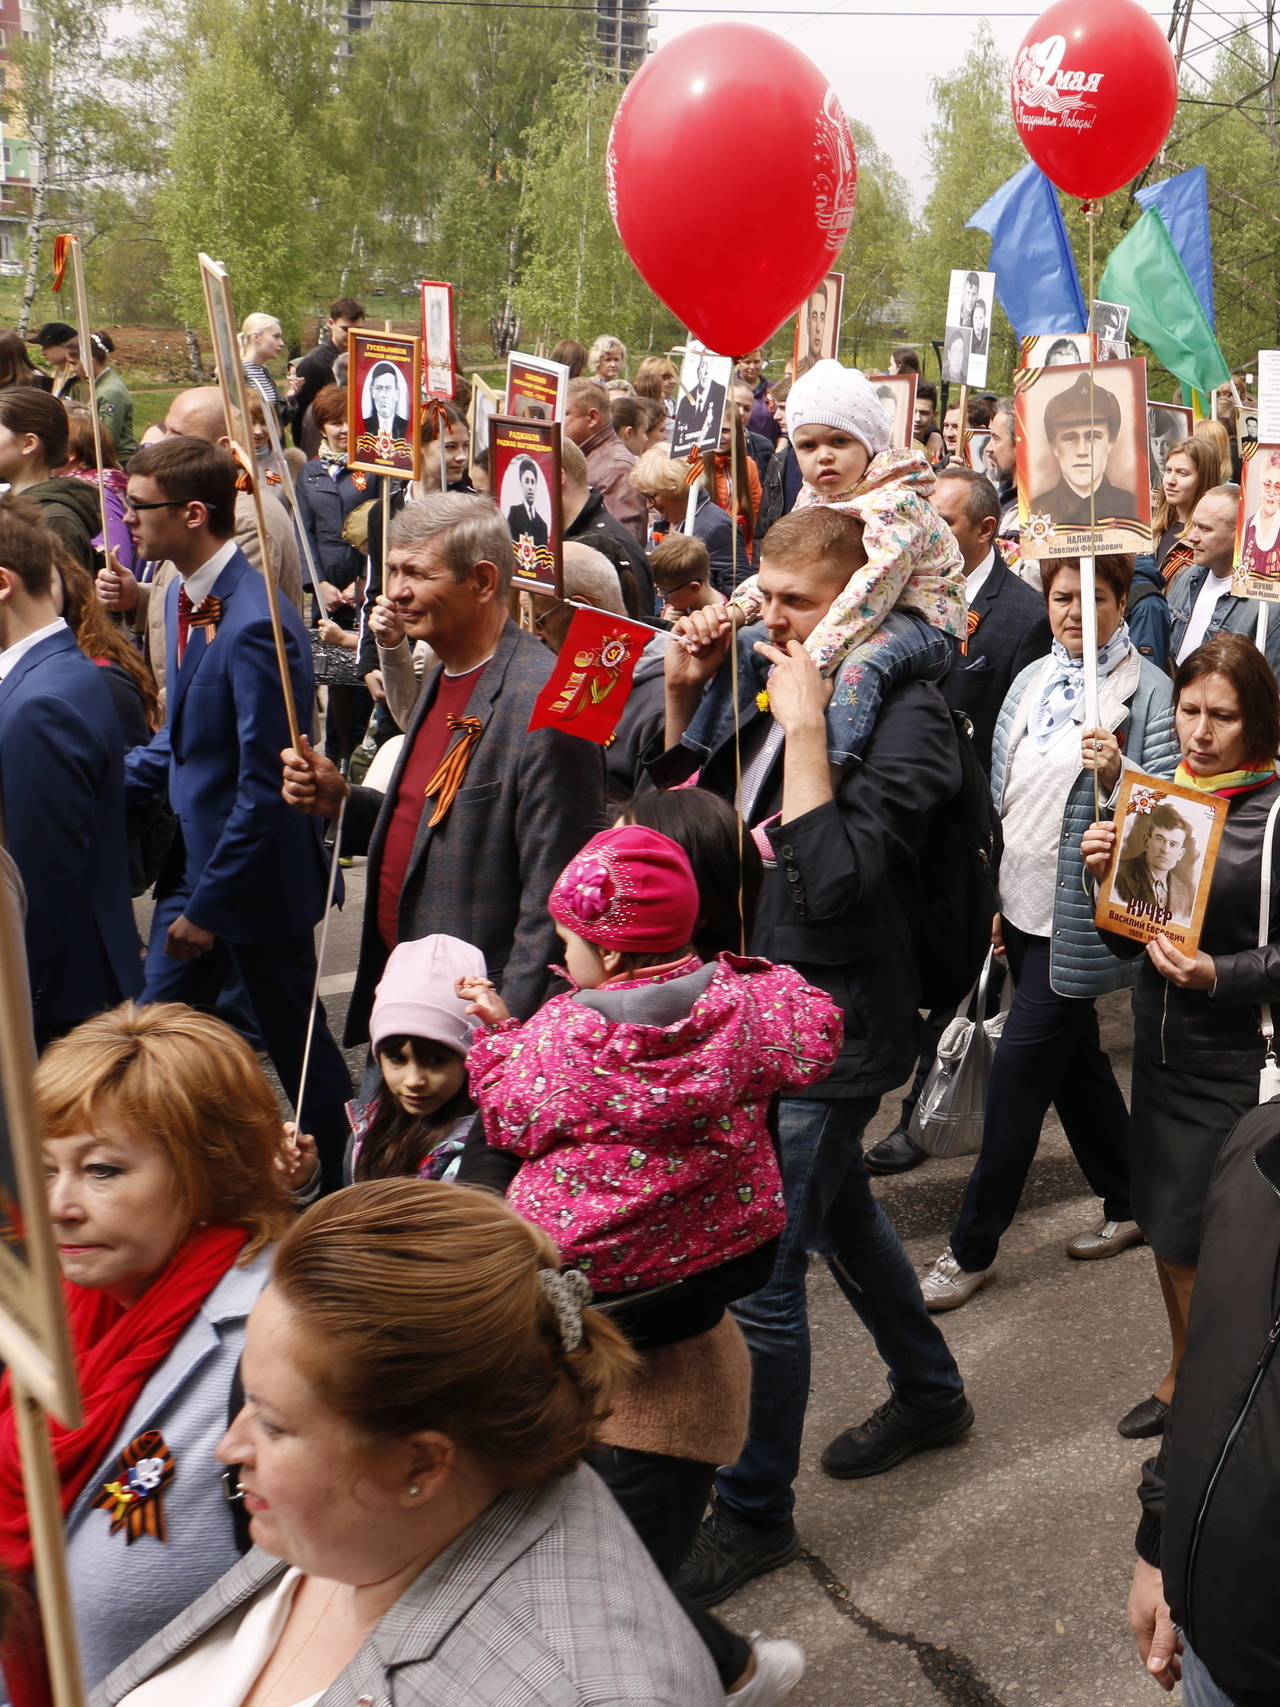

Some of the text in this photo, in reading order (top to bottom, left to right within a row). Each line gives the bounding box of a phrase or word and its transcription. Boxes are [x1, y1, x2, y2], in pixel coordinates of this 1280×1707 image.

[1053, 69, 1104, 92] мая
[508, 430, 541, 442] РАДЖАБОВ
[1066, 533, 1104, 545] НАЛИМОВ
[1048, 545, 1079, 555] Савелий
[1126, 897, 1173, 927] КУЧЕР
[1108, 910, 1146, 931] Василий
